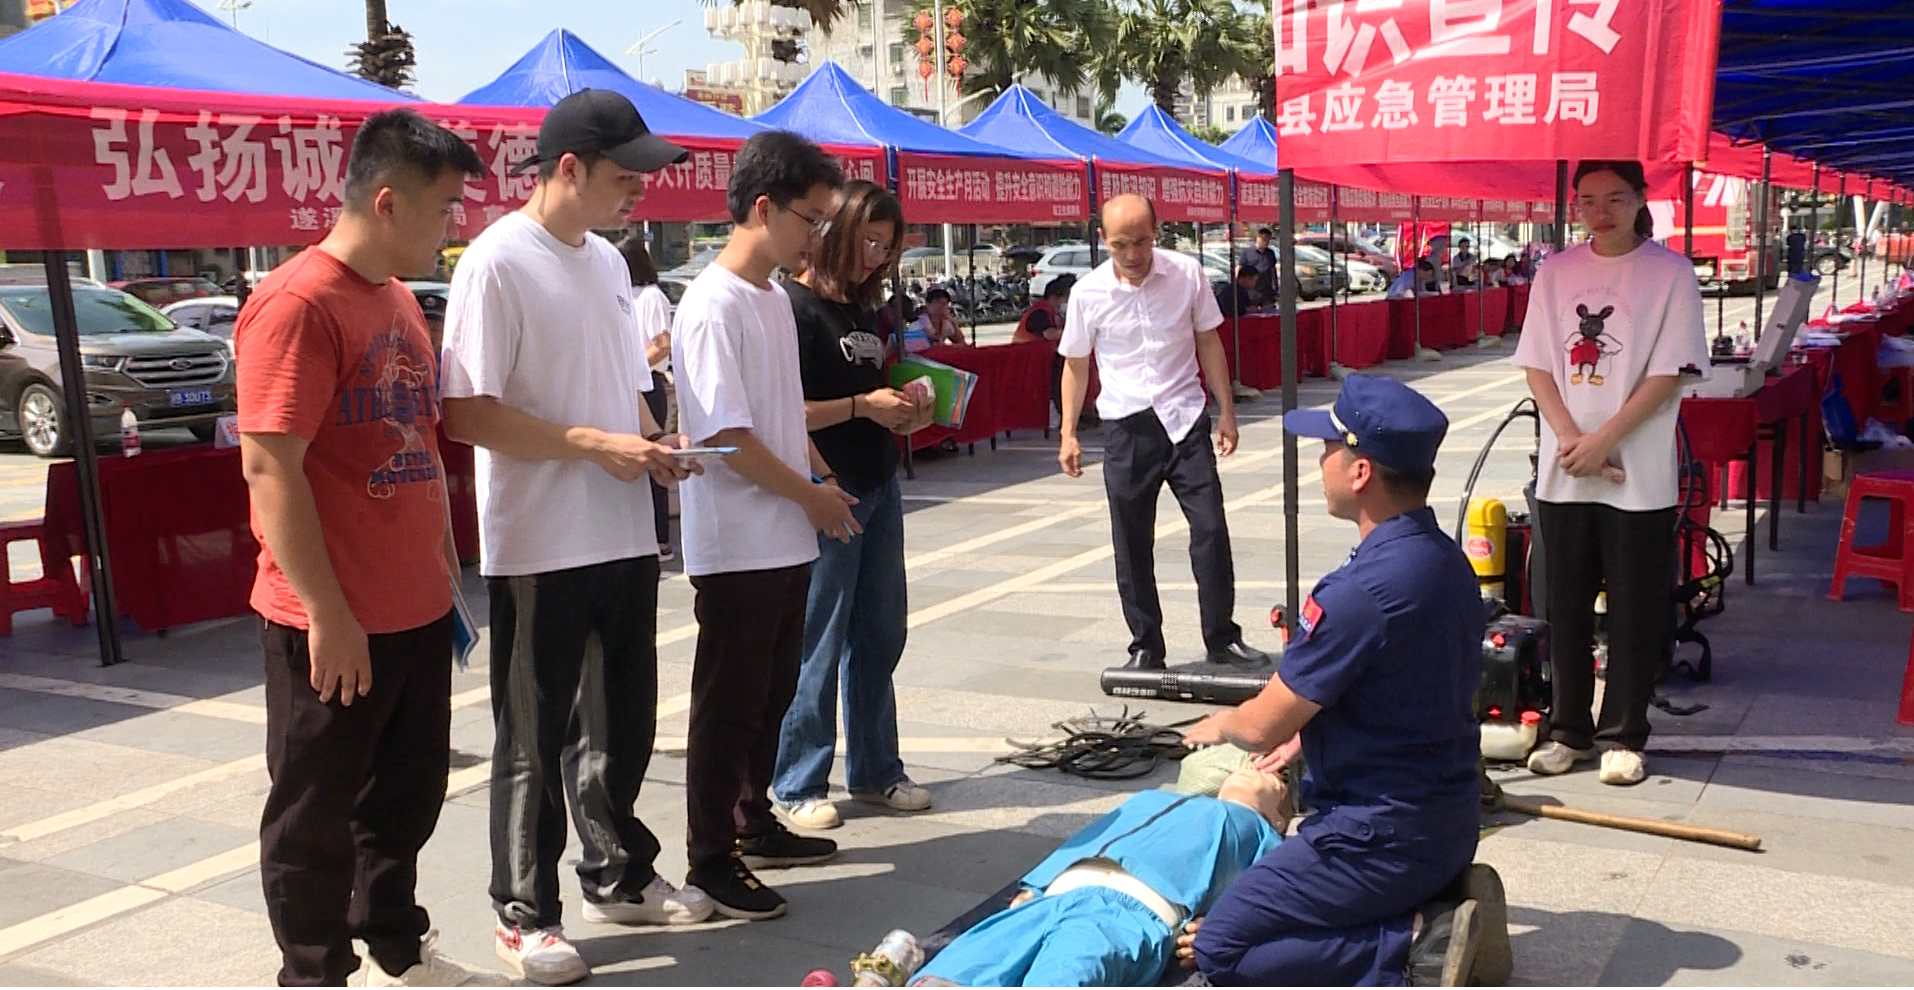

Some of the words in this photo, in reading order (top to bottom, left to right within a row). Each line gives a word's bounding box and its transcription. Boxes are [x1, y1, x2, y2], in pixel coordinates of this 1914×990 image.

[1277, 71, 1601, 137] 县应急管理局
